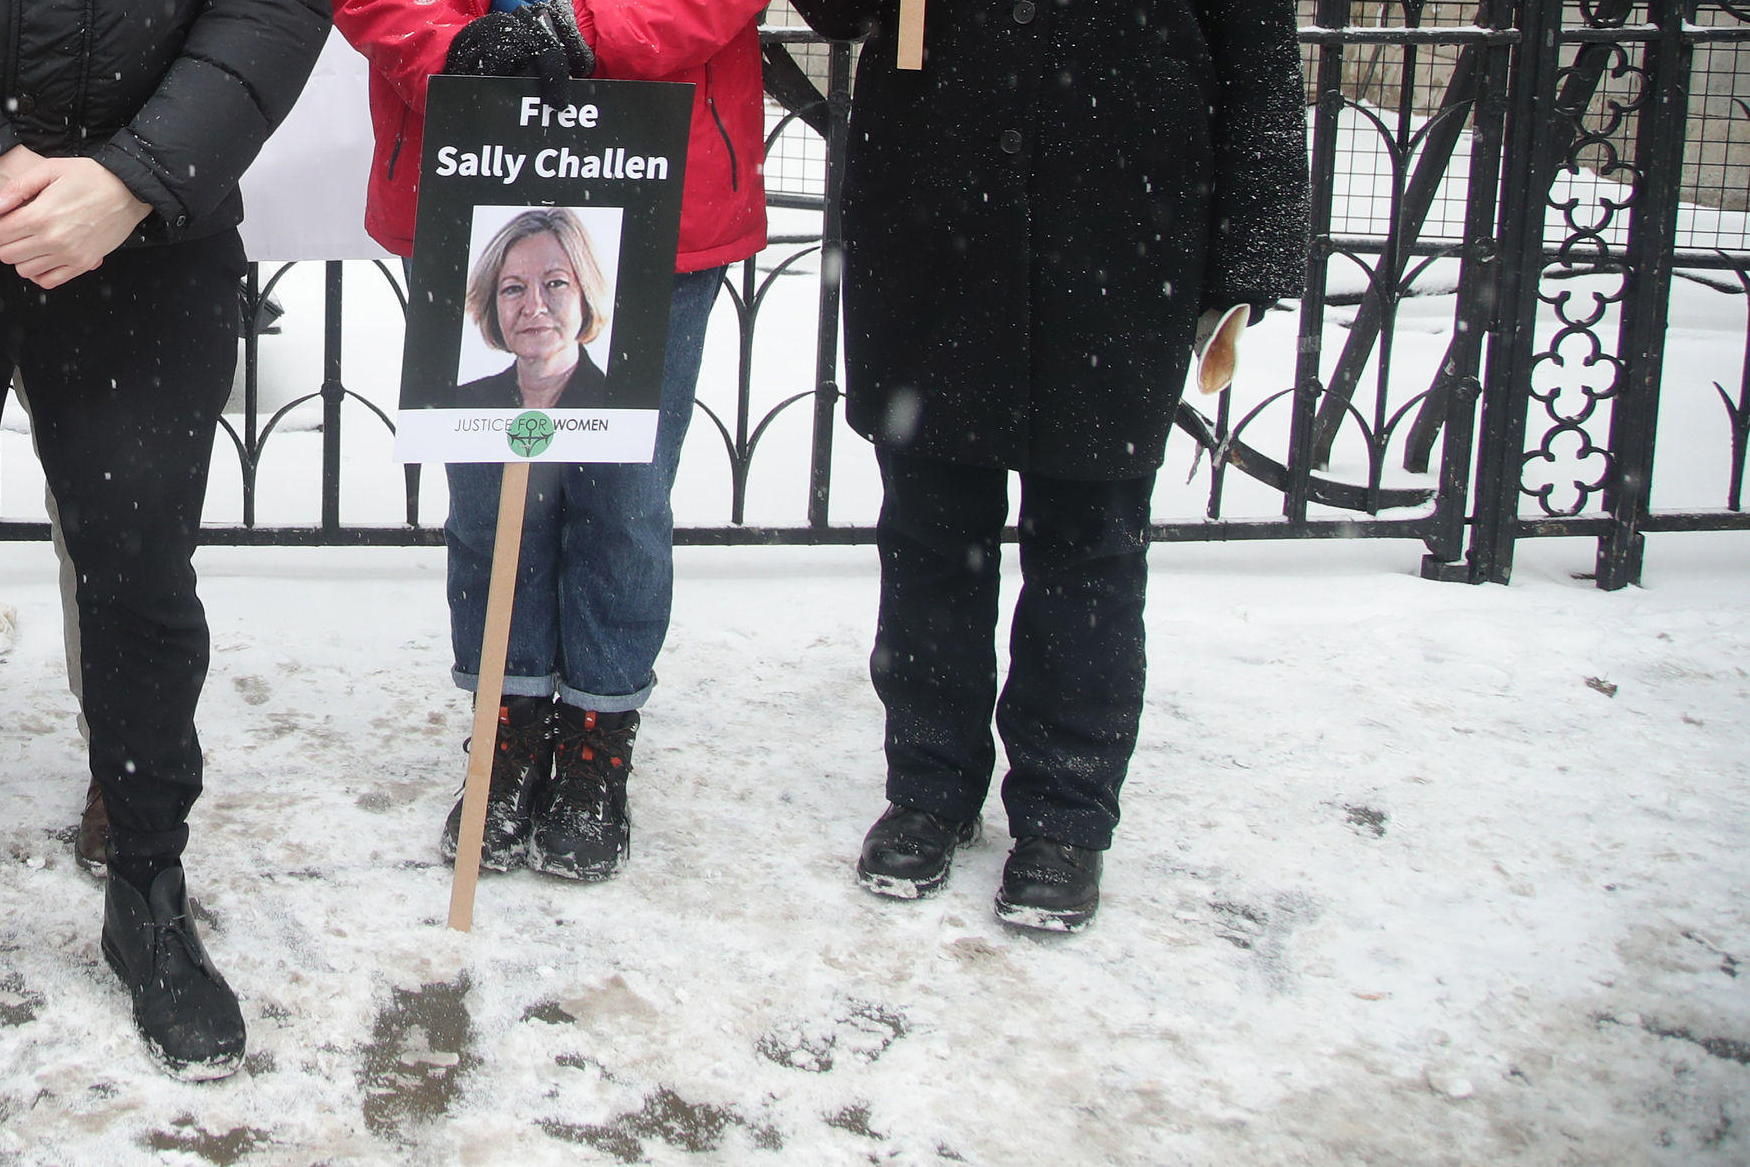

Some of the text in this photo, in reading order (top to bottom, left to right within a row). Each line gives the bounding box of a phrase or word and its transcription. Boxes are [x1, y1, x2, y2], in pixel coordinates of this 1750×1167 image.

[519, 96, 599, 128] Free
[435, 145, 669, 185] Sally Challen
[455, 418, 609, 432] JUSTICE FOR WOMEN
